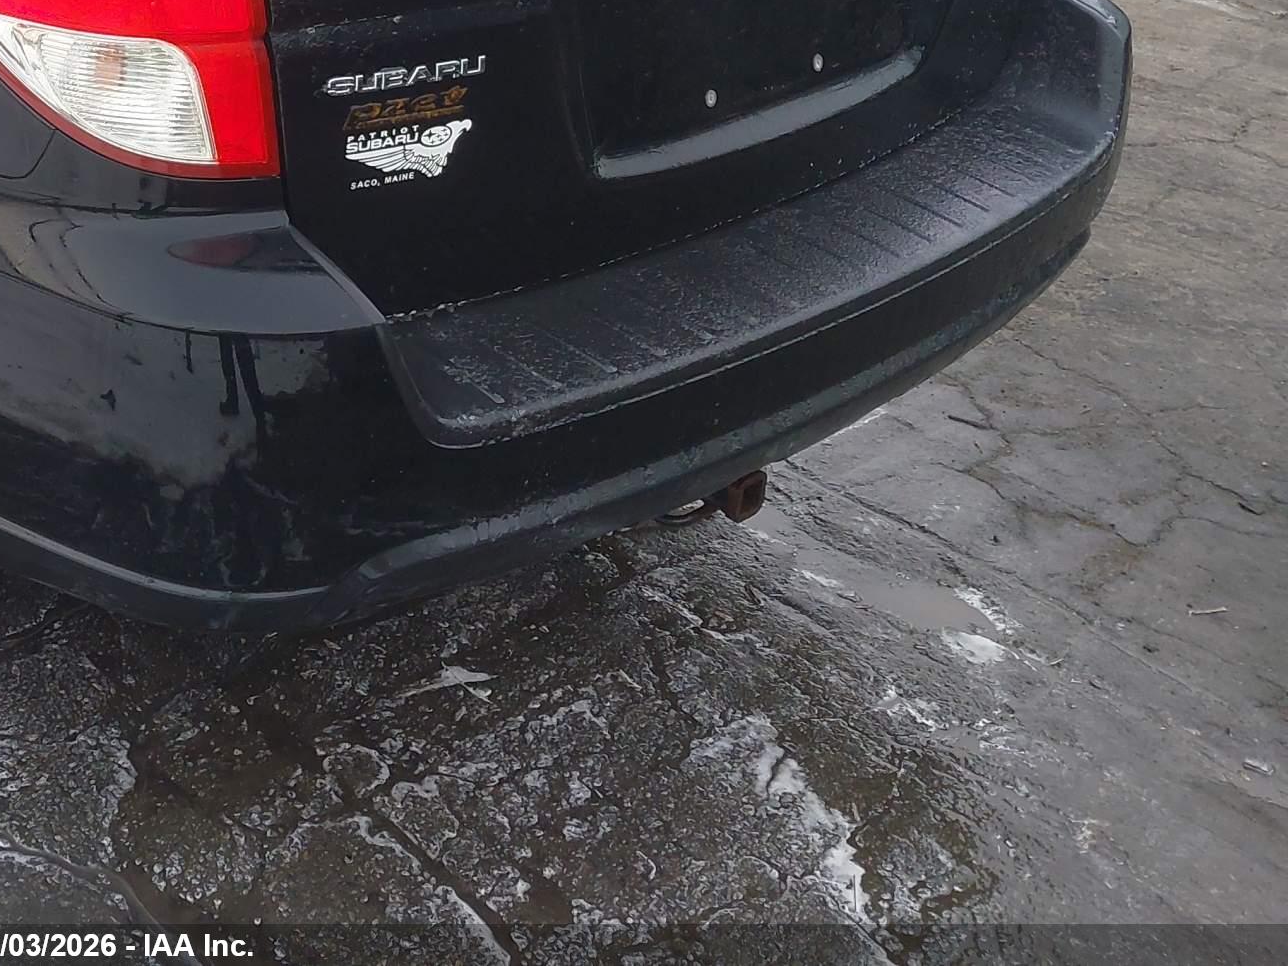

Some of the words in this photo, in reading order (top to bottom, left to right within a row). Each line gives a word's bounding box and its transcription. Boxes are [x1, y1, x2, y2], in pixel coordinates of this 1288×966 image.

[325, 54, 486, 96] SUBARU
[345, 132, 419, 154] SUBARU
[346, 124, 420, 144] PATRIOT
[350, 178, 381, 191] SACO,
[384, 171, 416, 185] MAINE
